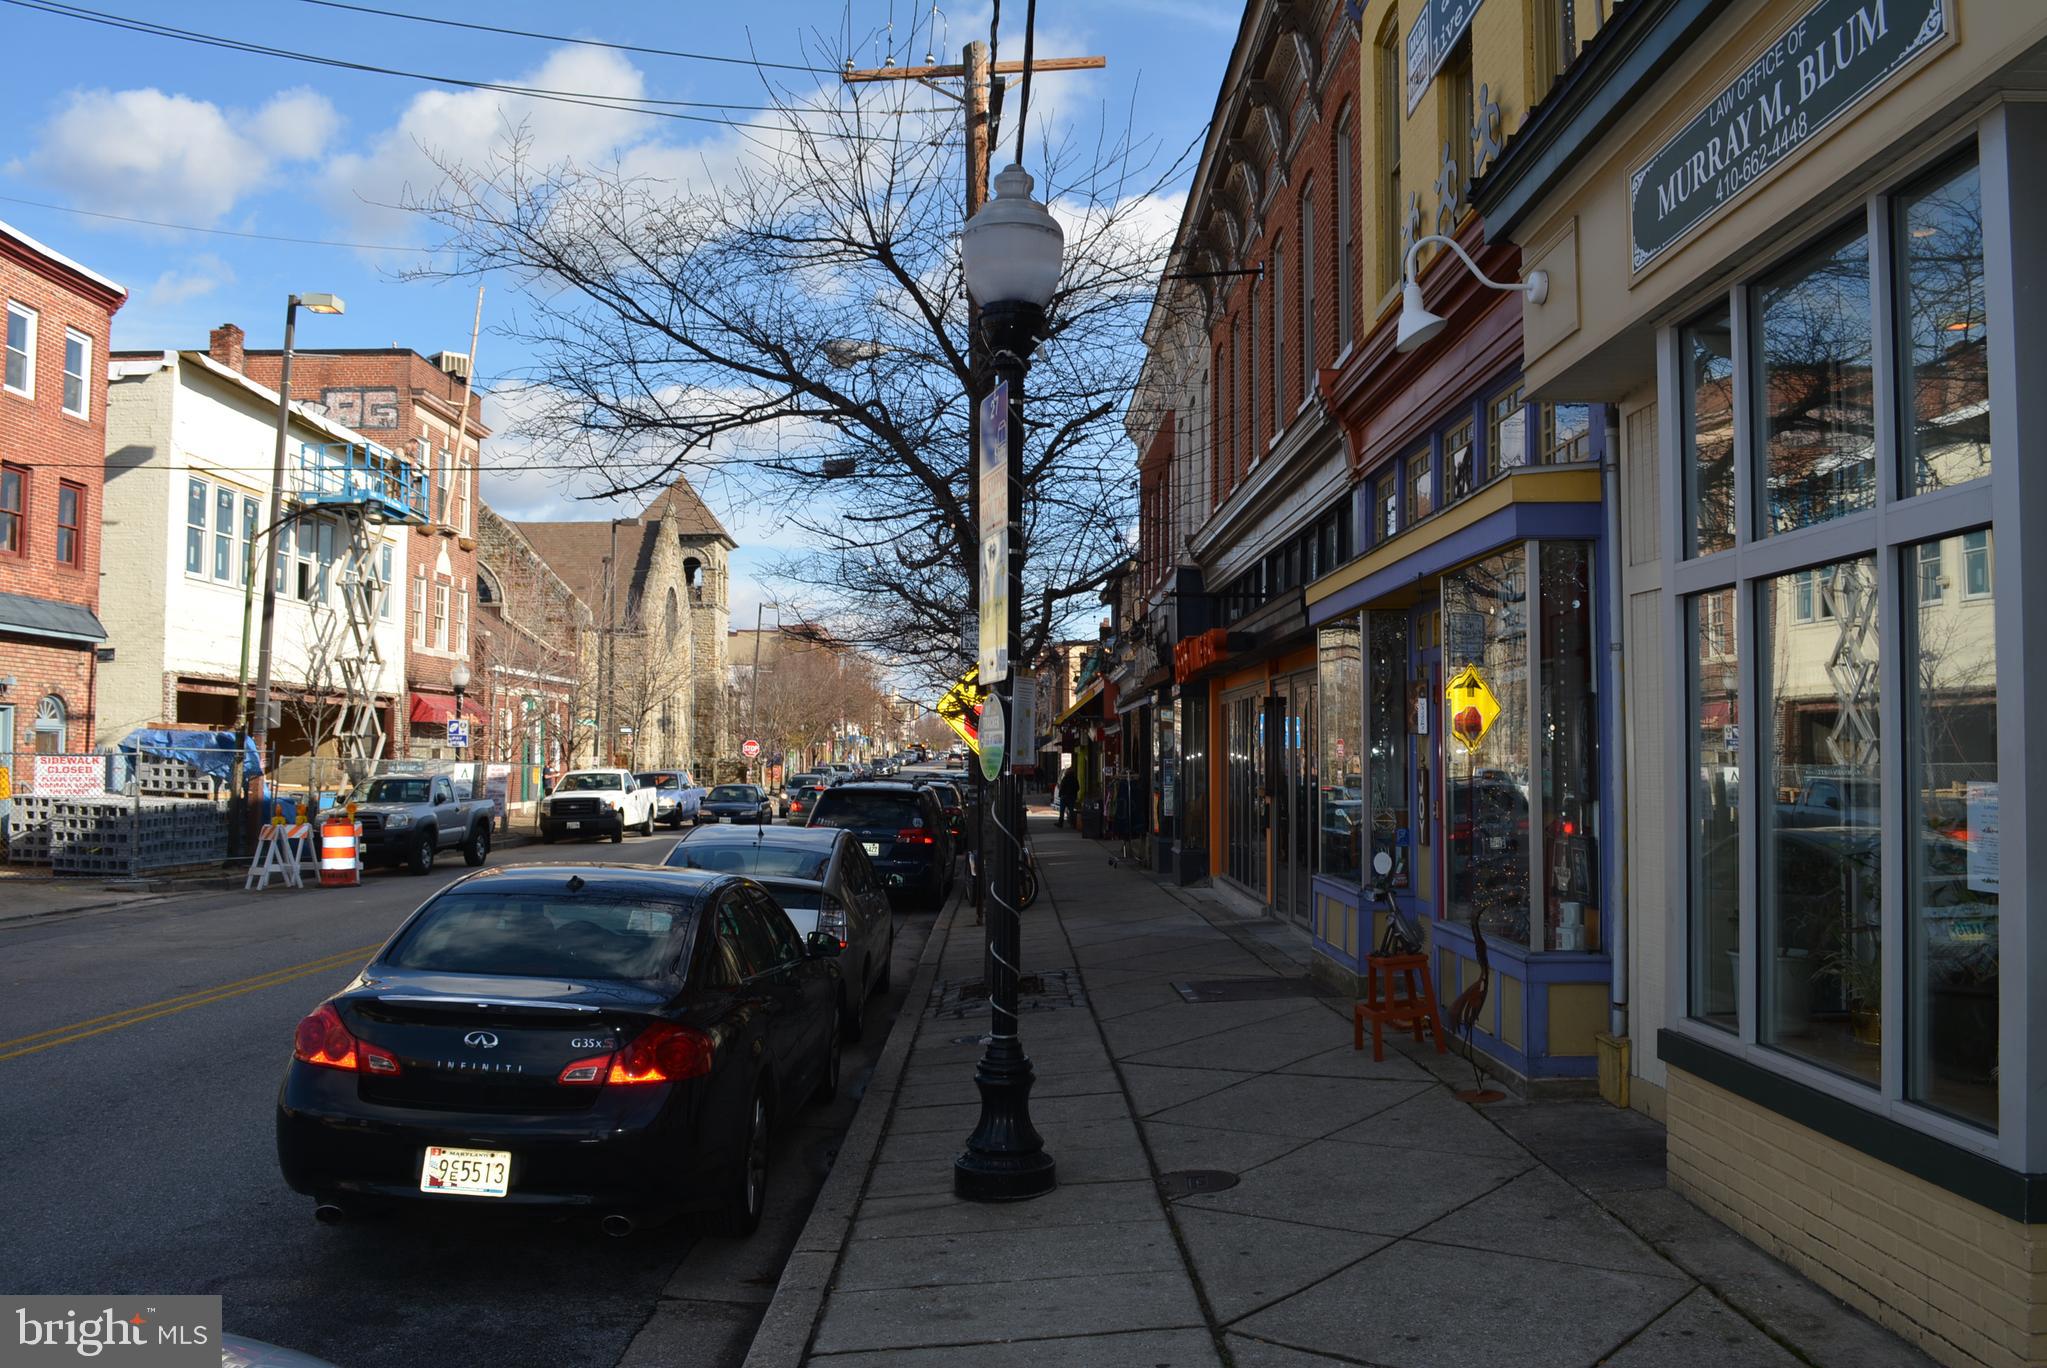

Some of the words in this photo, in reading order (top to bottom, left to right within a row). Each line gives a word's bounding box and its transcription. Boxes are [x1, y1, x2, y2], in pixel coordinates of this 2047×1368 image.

[1410, 18, 1426, 57] MUD
[1433, 5, 1463, 62] live
[1709, 87, 1735, 127] LAW
[1737, 47, 1784, 101] OFFICE
[1787, 21, 1807, 55] OF
[1657, 104, 1754, 221] MURRAY
[1758, 79, 1791, 138] M.
[1796, 0, 1888, 104] BLUM
[1715, 111, 1808, 201] 410-662-4448
[990, 394, 999, 419] 27
[40, 756, 100, 764] SIDEWALK
[47, 766, 93, 774] CLOSED
[437, 1060, 523, 1073] INFINITI
